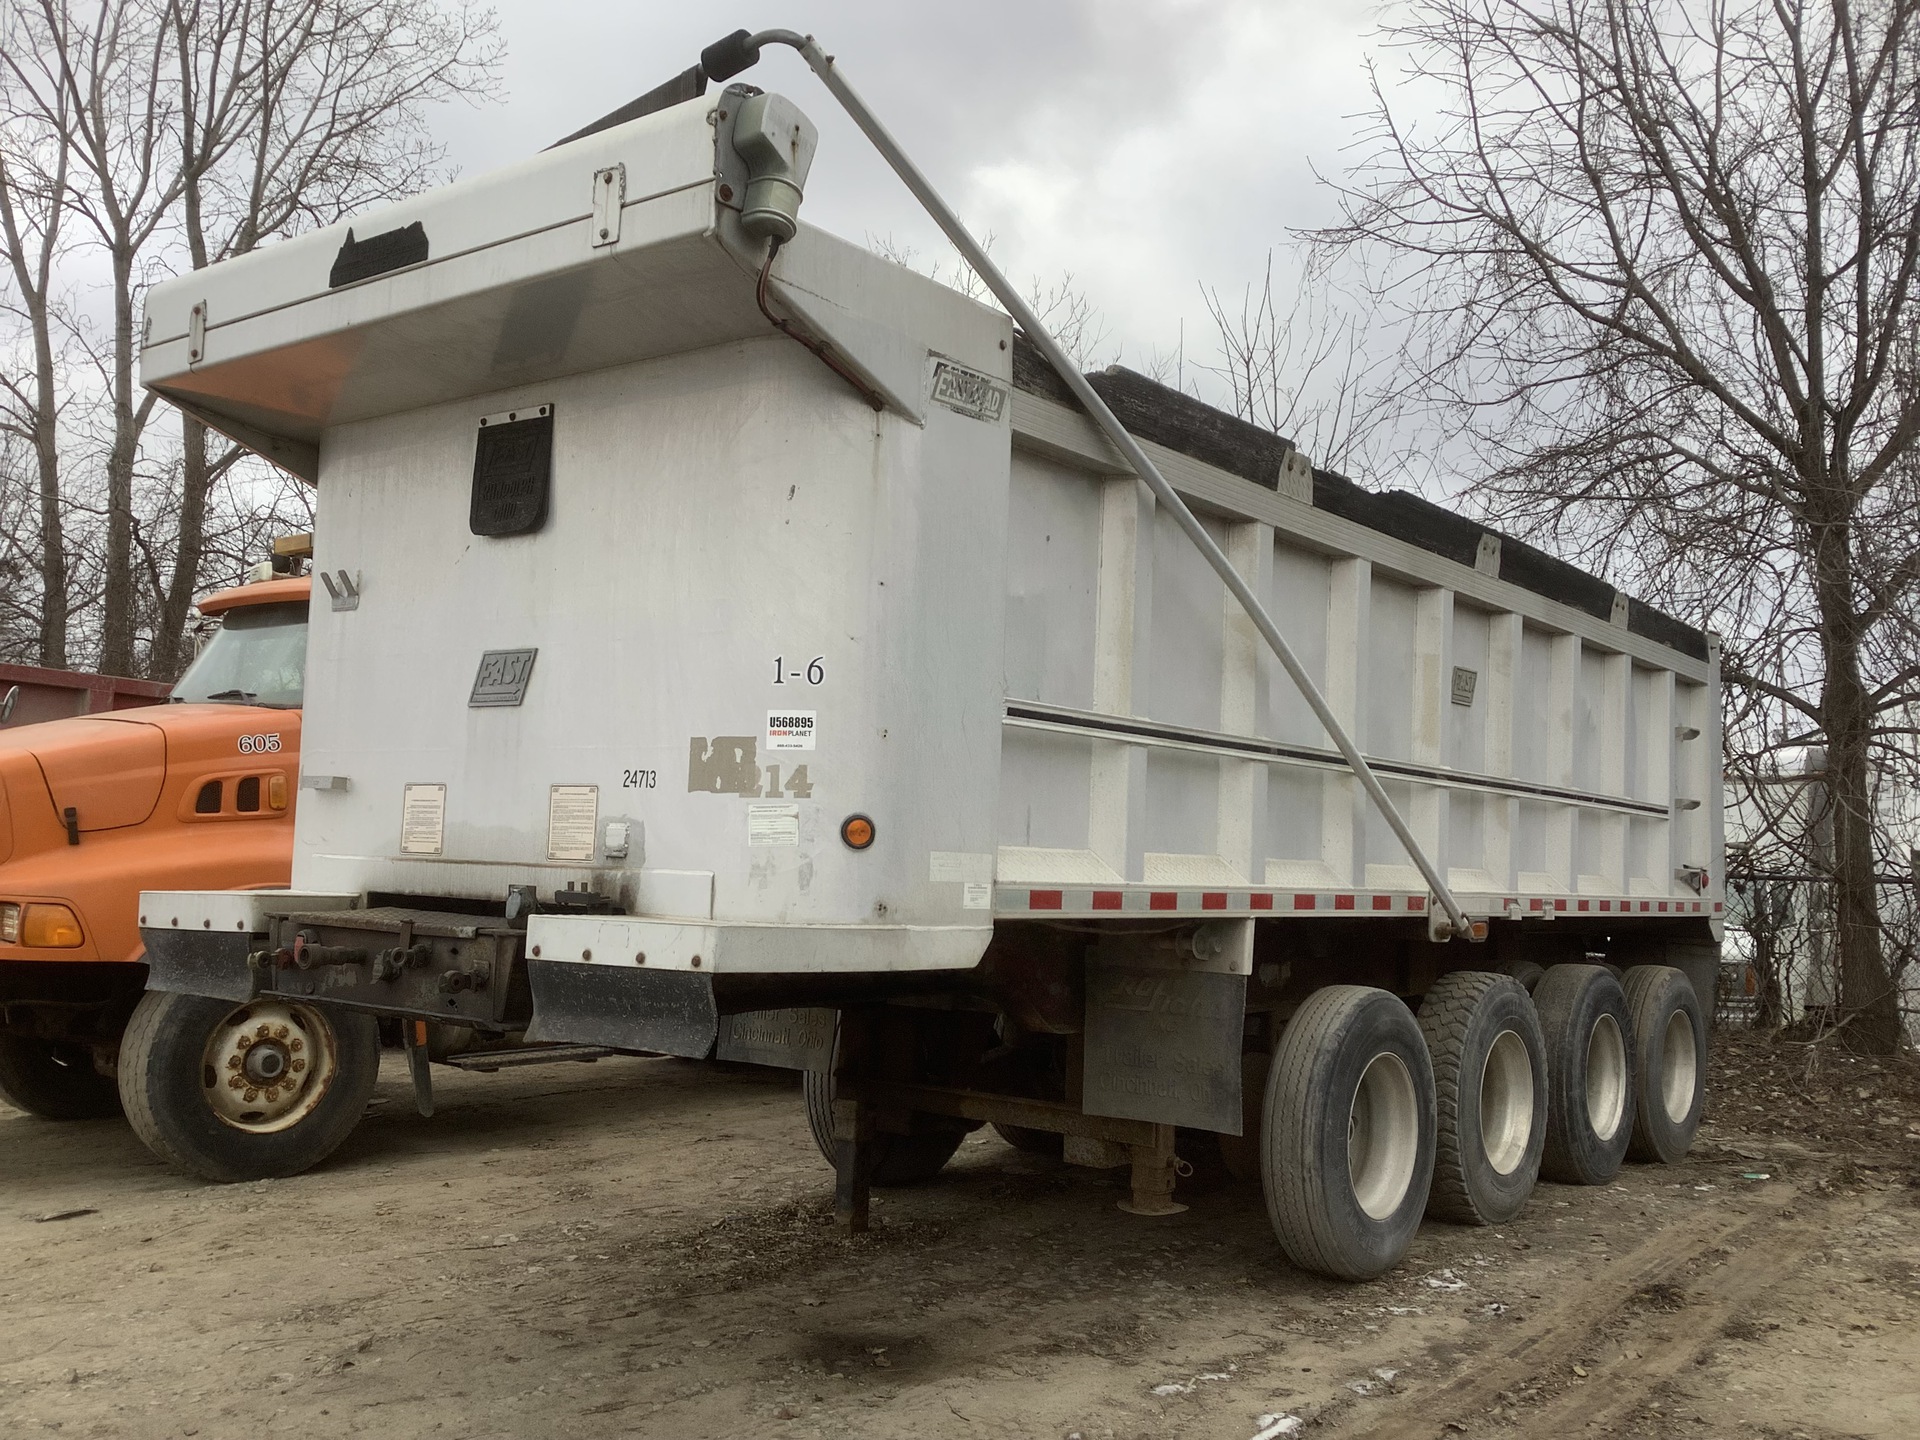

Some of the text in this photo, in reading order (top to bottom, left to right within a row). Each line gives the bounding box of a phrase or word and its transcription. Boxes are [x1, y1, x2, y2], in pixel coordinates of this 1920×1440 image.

[477, 654, 532, 690] EAST
[773, 656, 824, 685] 1-6
[769, 716, 814, 729] U568895
[237, 733, 282, 754] 605
[622, 769, 657, 789] 24713
[799, 1028, 824, 1051] Ohio
